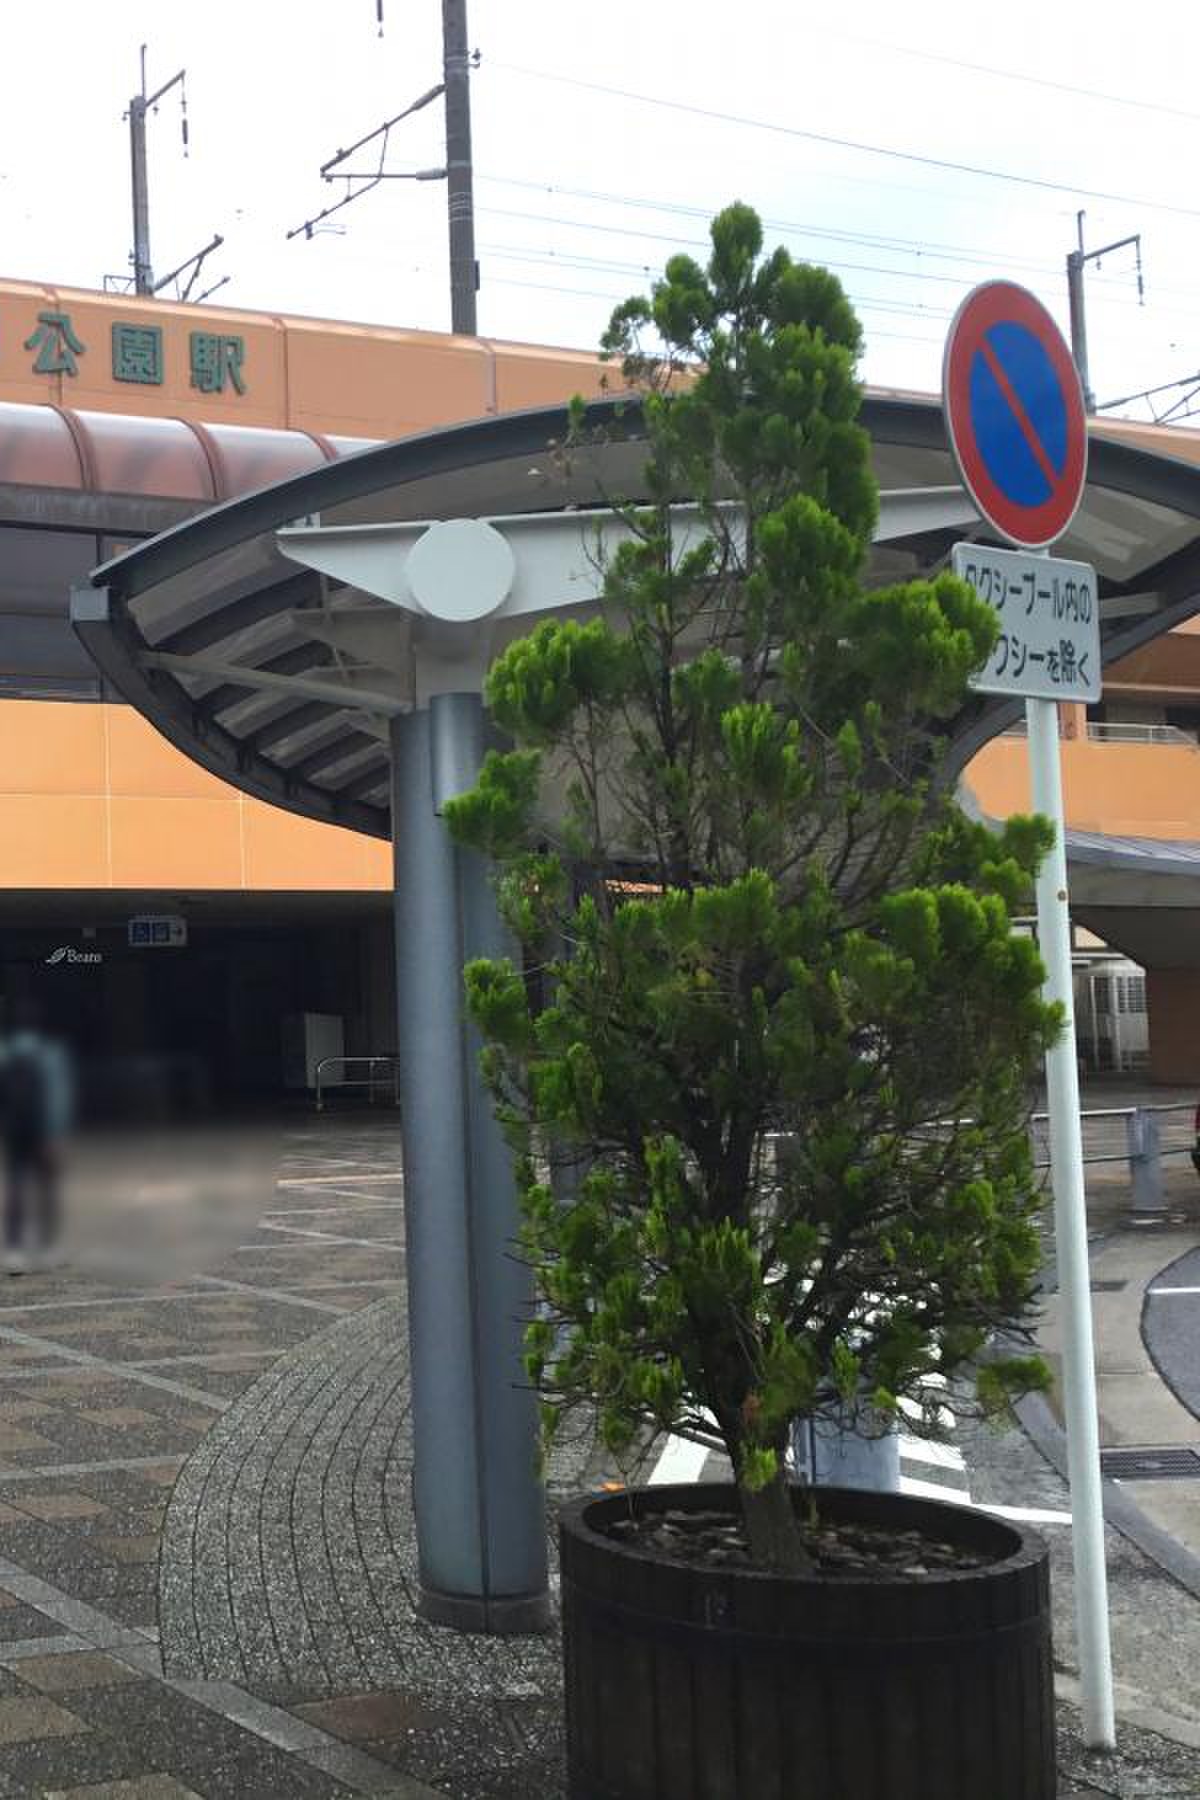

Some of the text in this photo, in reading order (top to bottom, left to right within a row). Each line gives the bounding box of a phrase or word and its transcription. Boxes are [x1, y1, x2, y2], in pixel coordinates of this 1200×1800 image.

[980, 634, 1090, 687] クシーを除く
